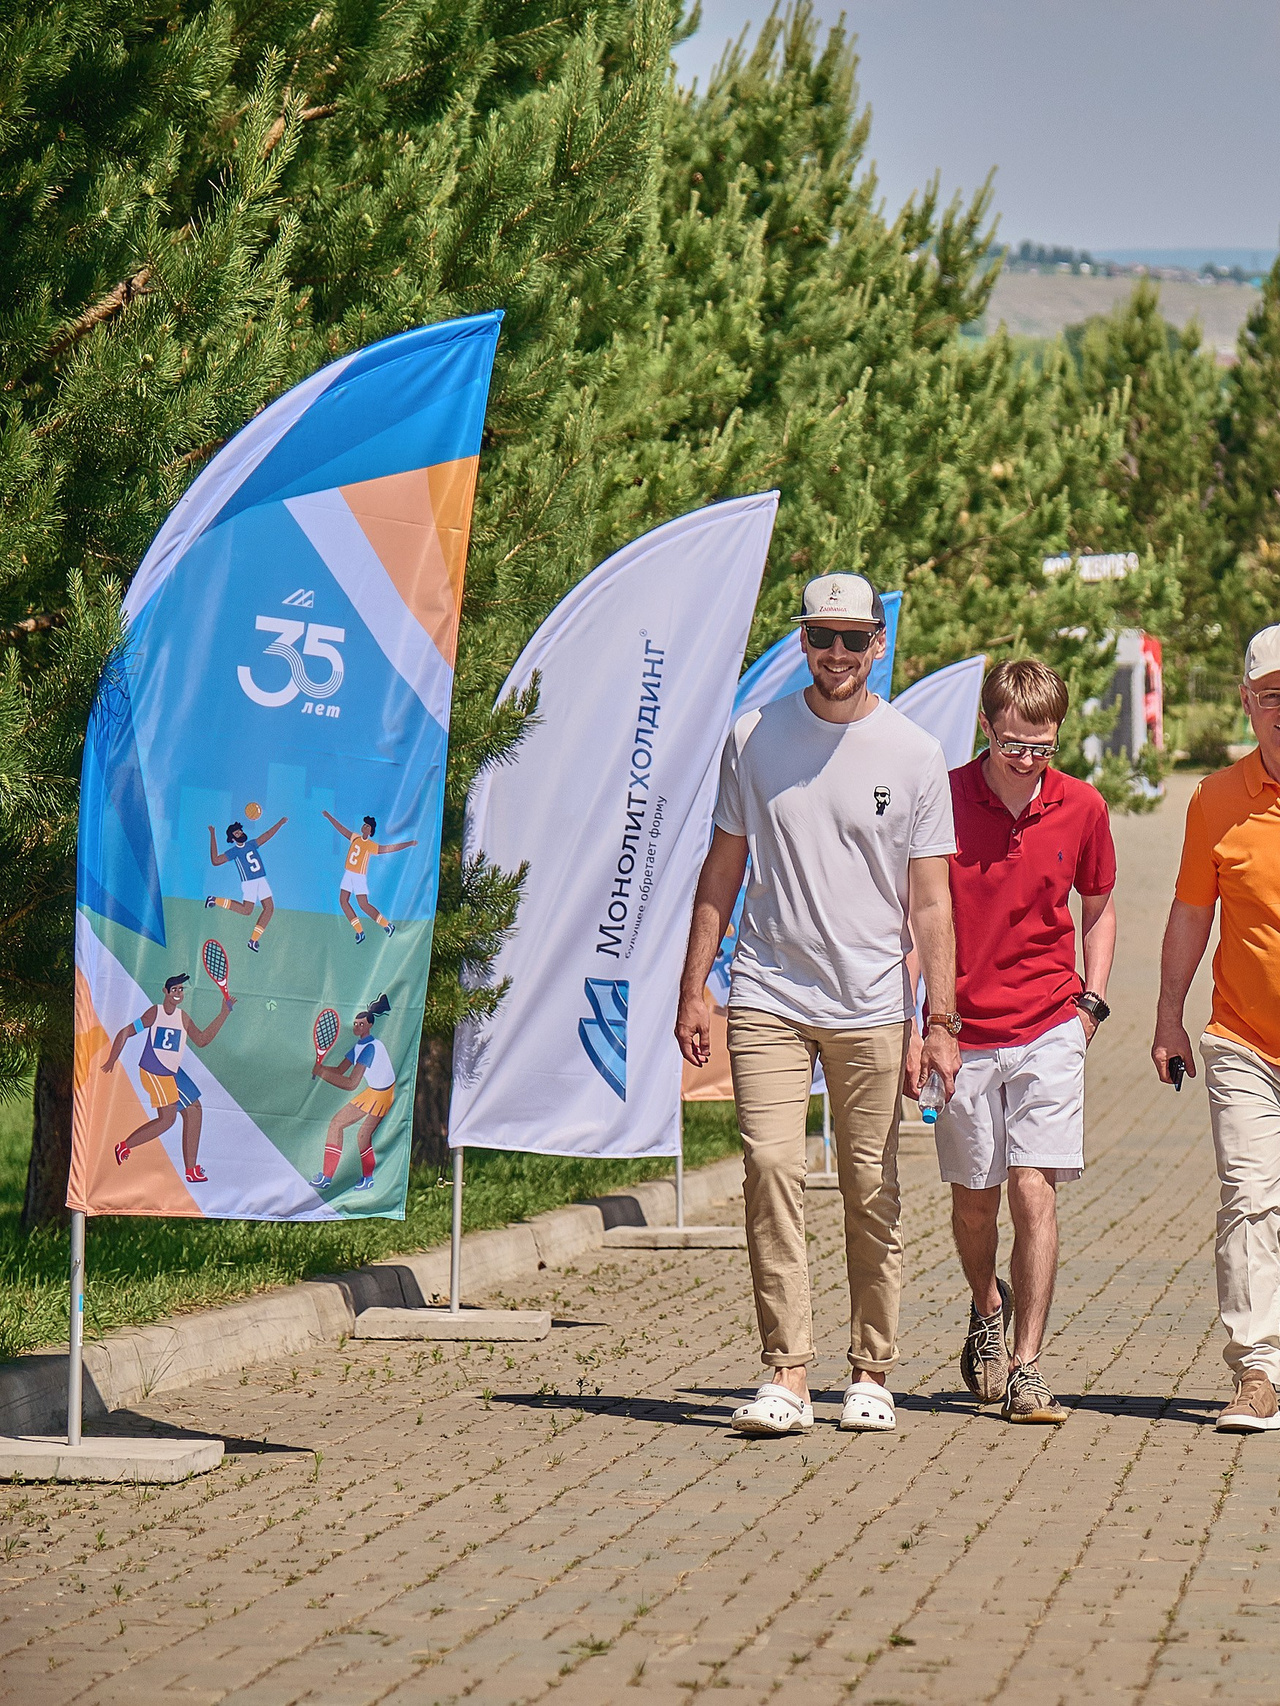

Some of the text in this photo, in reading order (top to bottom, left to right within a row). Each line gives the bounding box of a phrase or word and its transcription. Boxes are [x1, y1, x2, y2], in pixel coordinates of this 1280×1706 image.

[237, 614, 345, 707] 35
[301, 701, 340, 718] лет
[641, 844, 657, 901] обретает
[649, 795, 668, 838] форму
